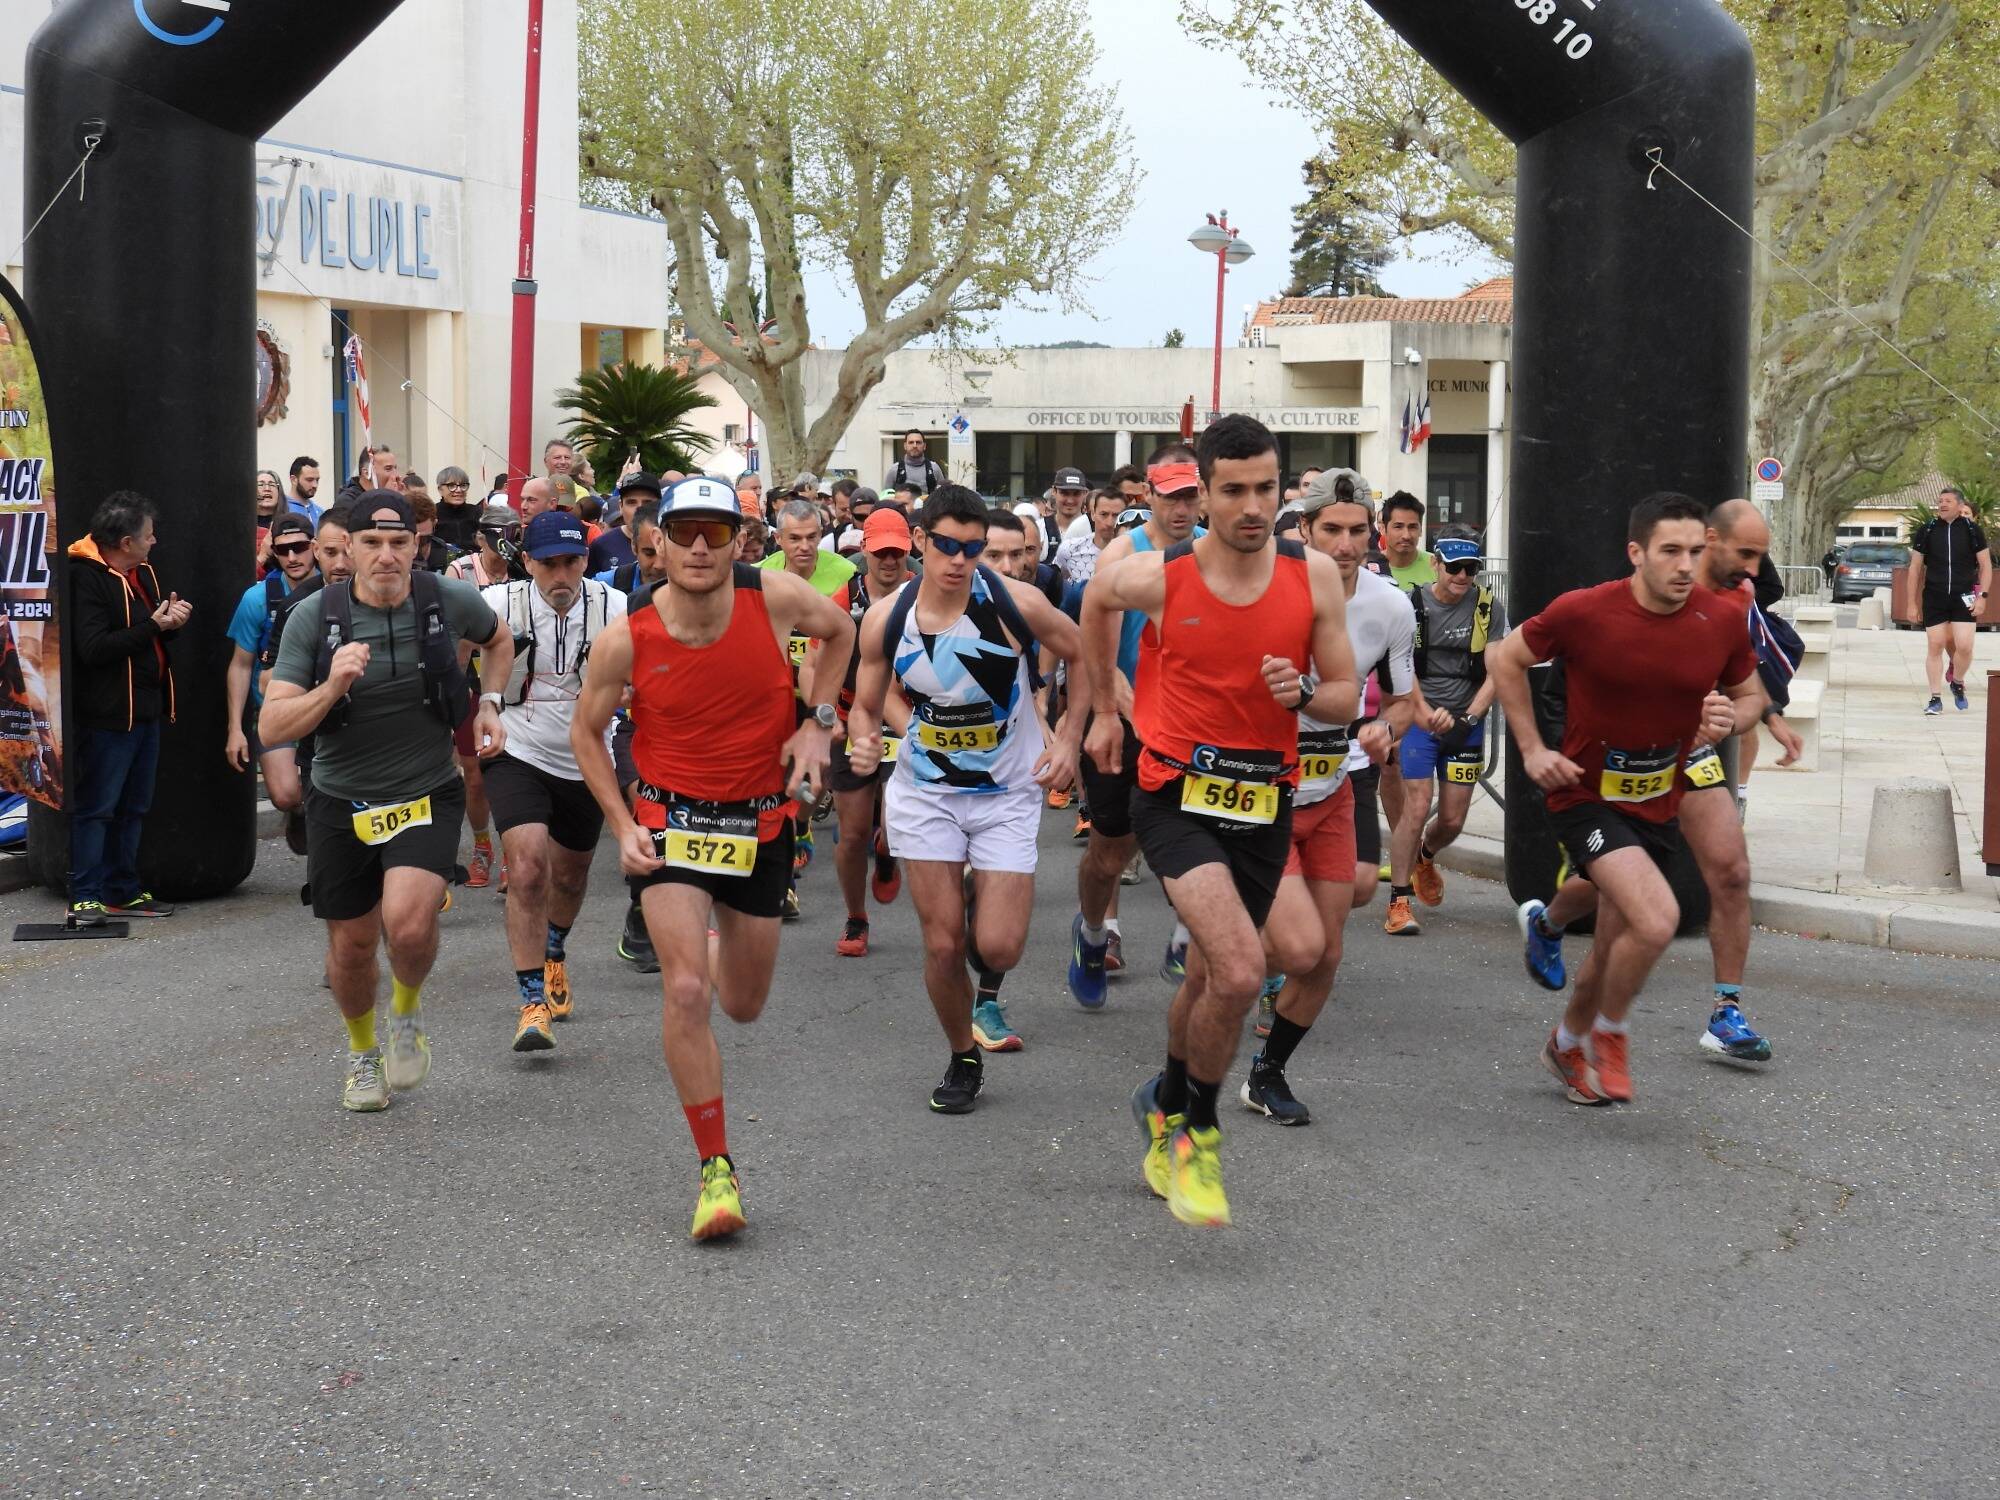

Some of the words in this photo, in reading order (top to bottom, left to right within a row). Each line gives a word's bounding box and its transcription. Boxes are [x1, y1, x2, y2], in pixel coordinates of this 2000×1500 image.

[1553, 18, 1593, 60] 10
[1028, 412, 1086, 425] OFFICE
[1090, 412, 1112, 425] DU
[1281, 412, 1360, 425] CULTURE
[14, 602, 52, 617] 2024
[935, 731, 979, 748] 543
[1619, 776, 1663, 795] 552
[1204, 783, 1257, 813] 596
[370, 807, 412, 836] 503
[686, 839, 736, 865] 572
